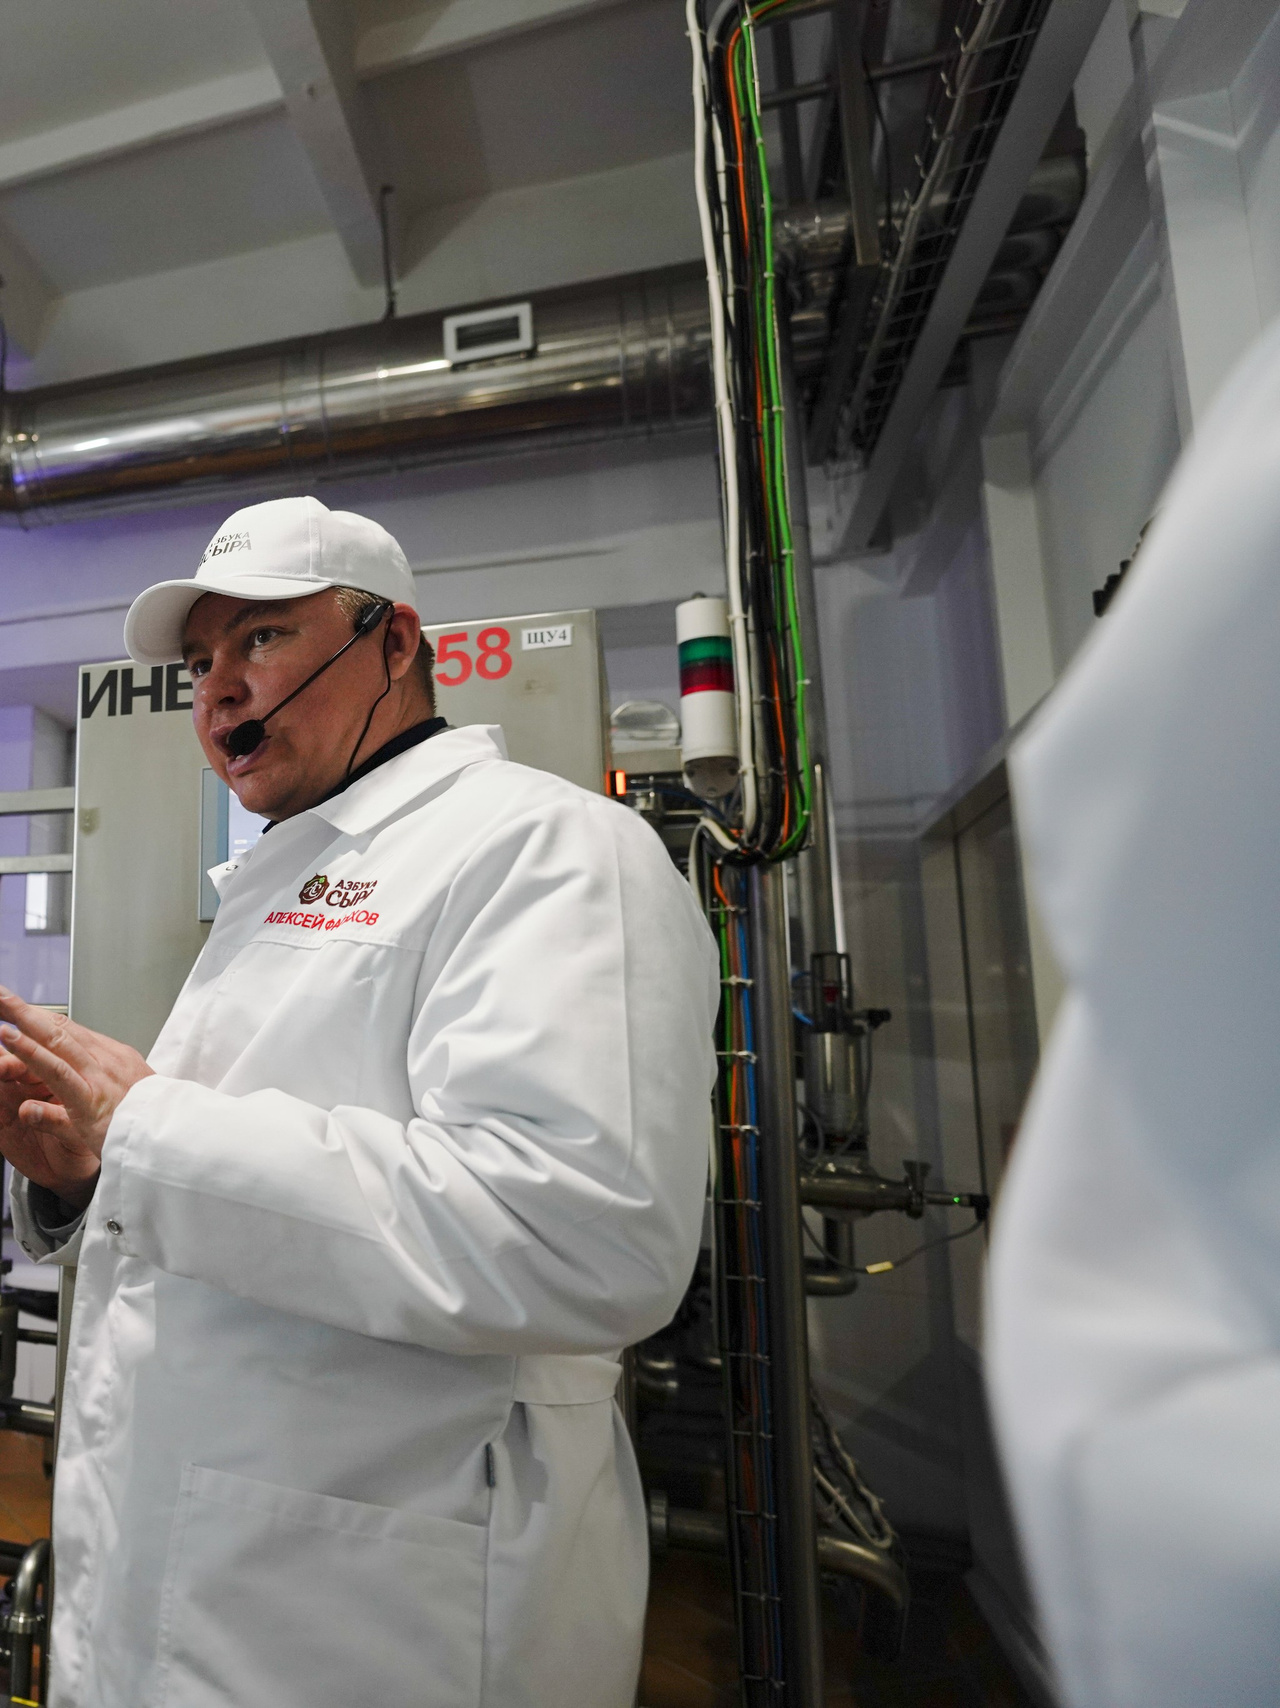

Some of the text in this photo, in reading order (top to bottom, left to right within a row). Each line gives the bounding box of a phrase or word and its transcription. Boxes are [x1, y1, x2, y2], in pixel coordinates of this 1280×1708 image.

[527, 629, 567, 645] ЩУ4
[335, 879, 378, 892] АЗБУКА
[264, 911, 326, 931] АЛЕКСЕЙ
